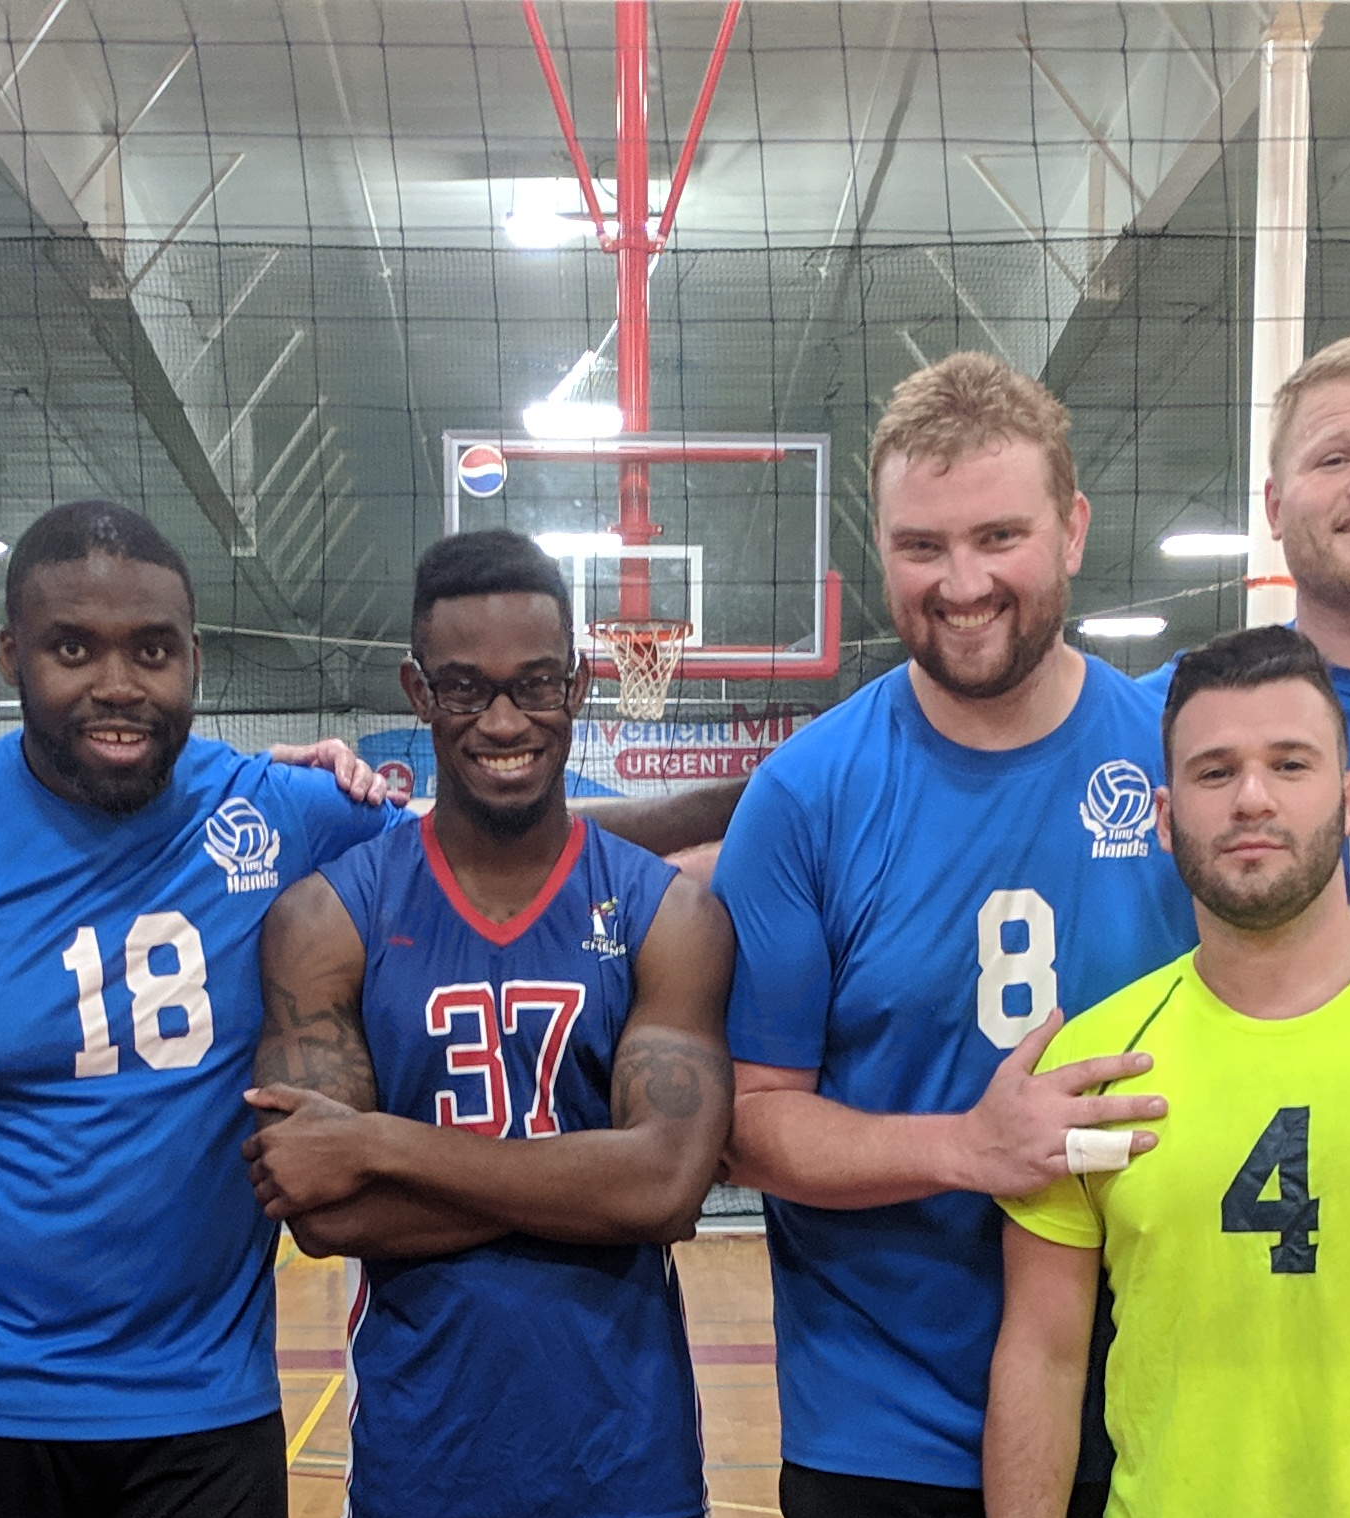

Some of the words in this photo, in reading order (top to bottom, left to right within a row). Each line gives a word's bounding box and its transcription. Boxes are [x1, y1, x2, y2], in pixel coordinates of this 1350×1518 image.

[626, 754, 732, 776] URGENT
[1092, 839, 1149, 859] Hands
[1108, 828, 1134, 840] Tiny
[227, 870, 278, 894] Hands
[62, 910, 214, 1078] 18
[977, 888, 1057, 1050] 8
[426, 980, 586, 1139] 37
[1221, 1105, 1319, 1273] 4
